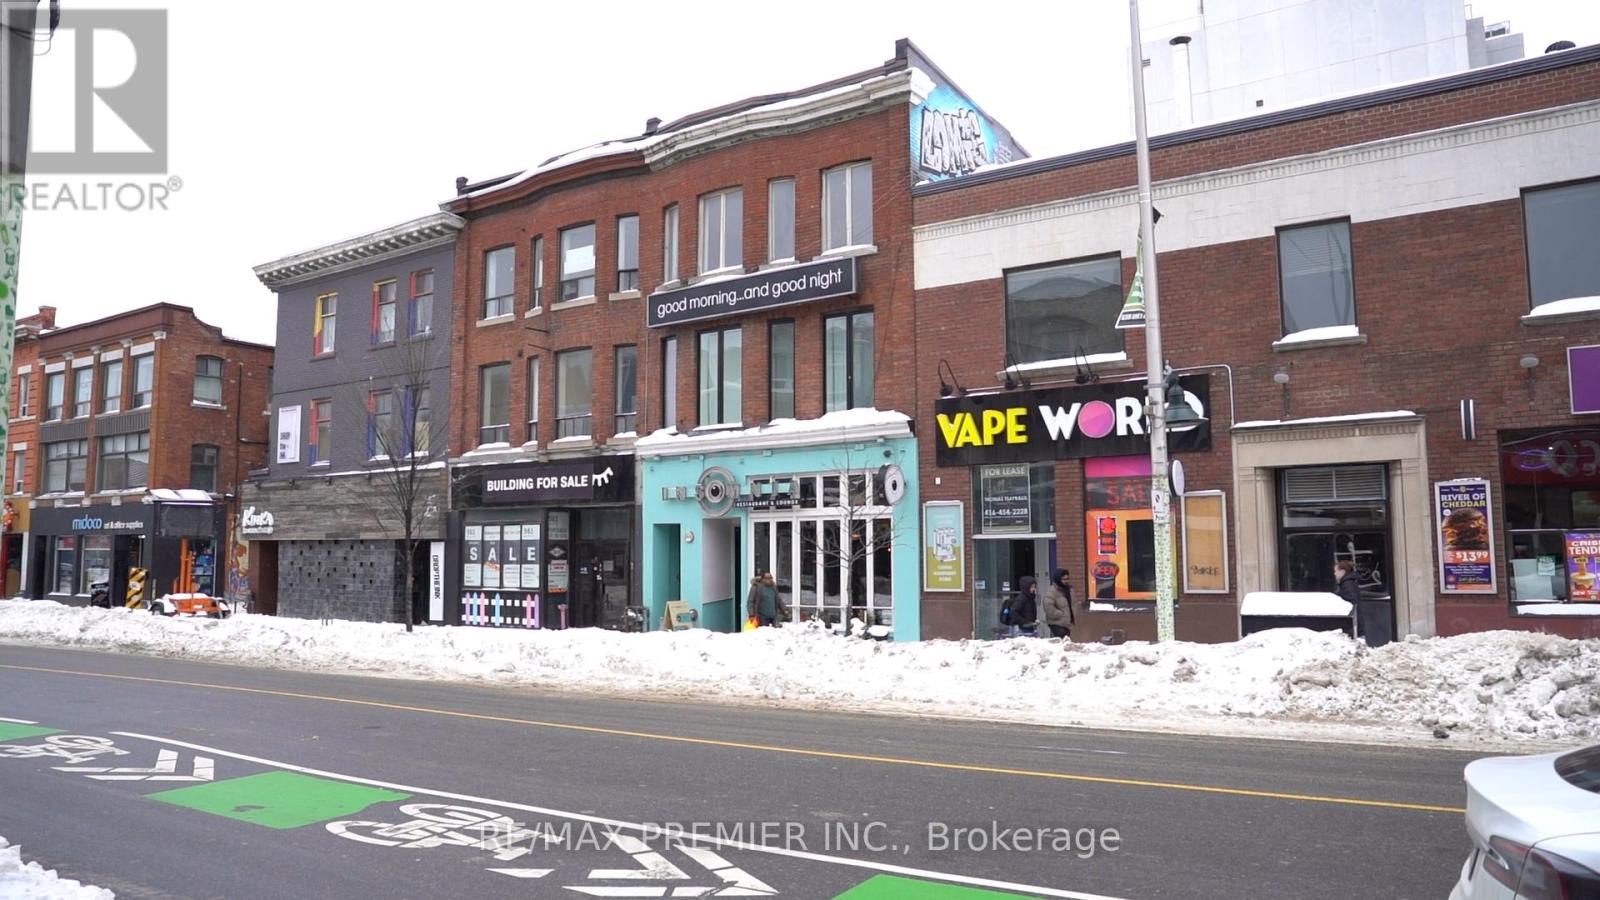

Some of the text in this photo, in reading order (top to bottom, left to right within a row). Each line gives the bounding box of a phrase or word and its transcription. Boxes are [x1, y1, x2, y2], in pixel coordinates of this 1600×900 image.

[657, 297, 687, 318] good
[772, 275, 806, 298] good
[809, 268, 843, 290] night
[936, 407, 1028, 449] VAPE
[984, 466, 1026, 476] FOR LEASE
[486, 475, 589, 492] BUILDING FOR SALE
[1440, 492, 1486, 502] RIVER OF
[1441, 500, 1487, 508] CHEDDAR
